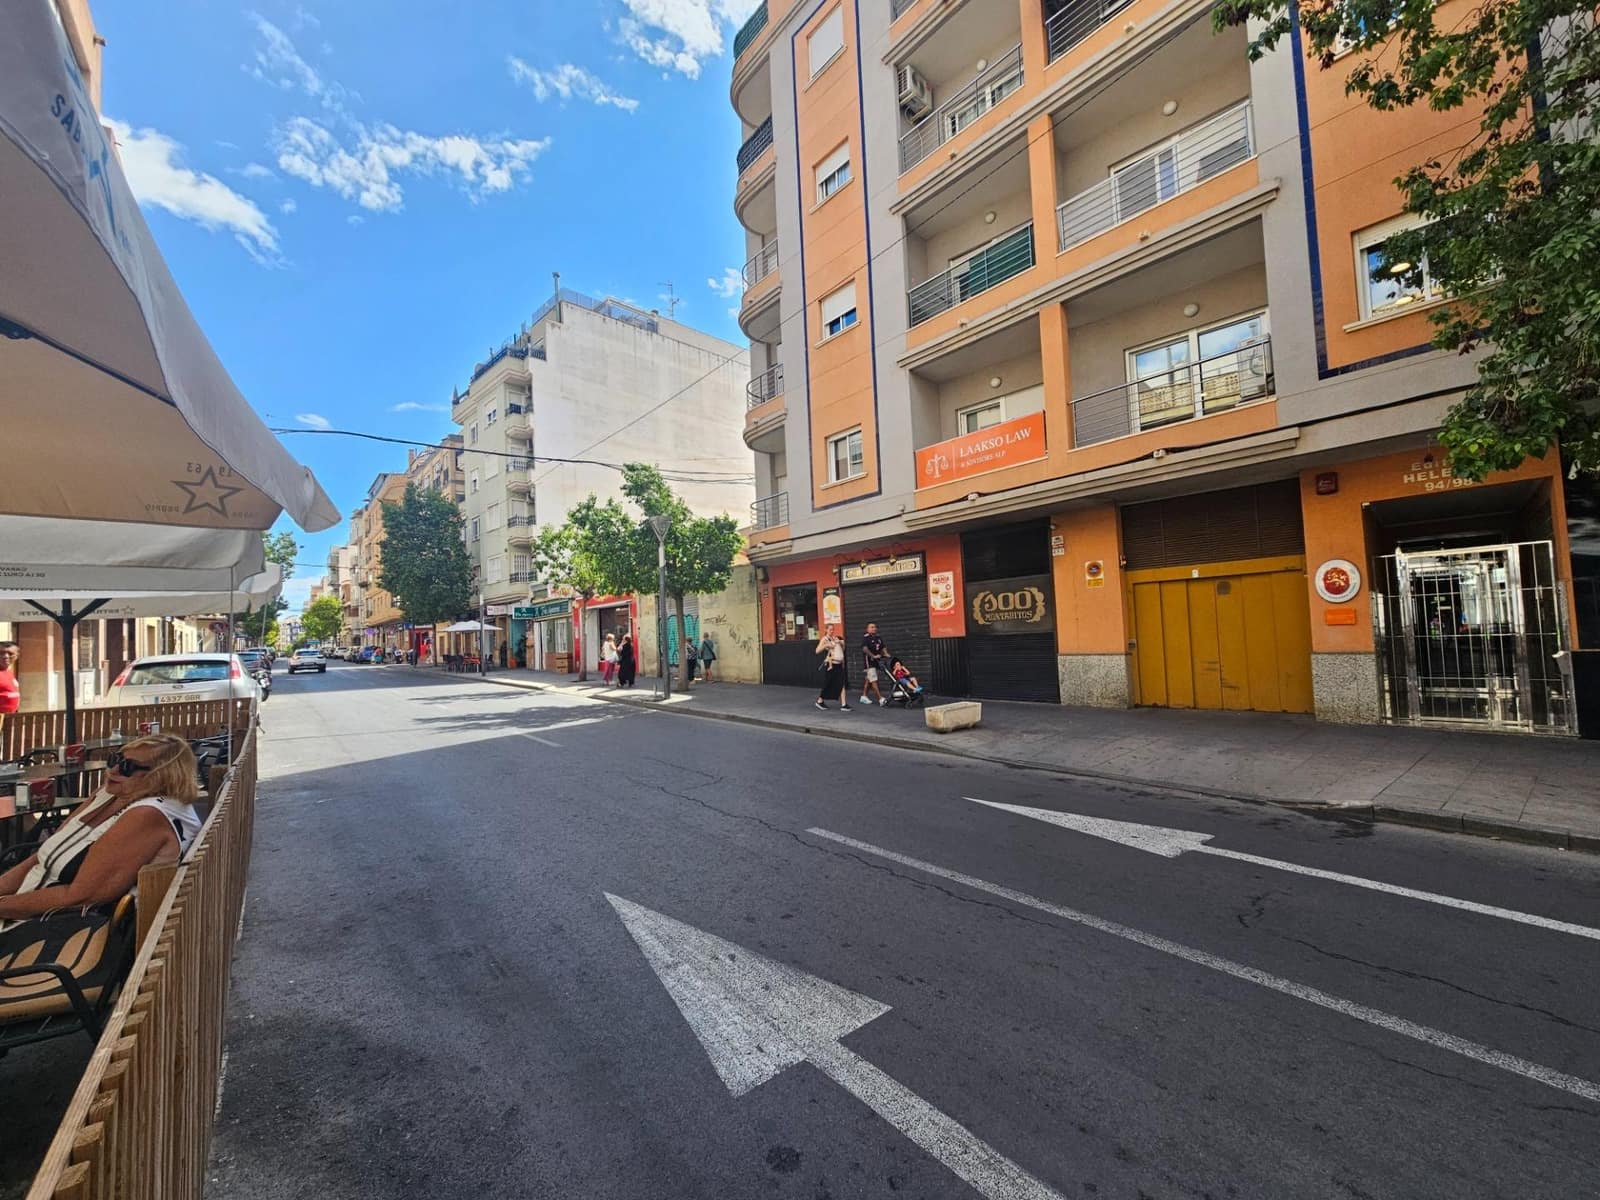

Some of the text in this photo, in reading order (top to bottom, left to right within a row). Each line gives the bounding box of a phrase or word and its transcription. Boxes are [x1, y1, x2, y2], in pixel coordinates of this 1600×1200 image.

[959, 427, 1032, 457] LAAKSO LAW
[1424, 477, 1473, 491] 94/98
